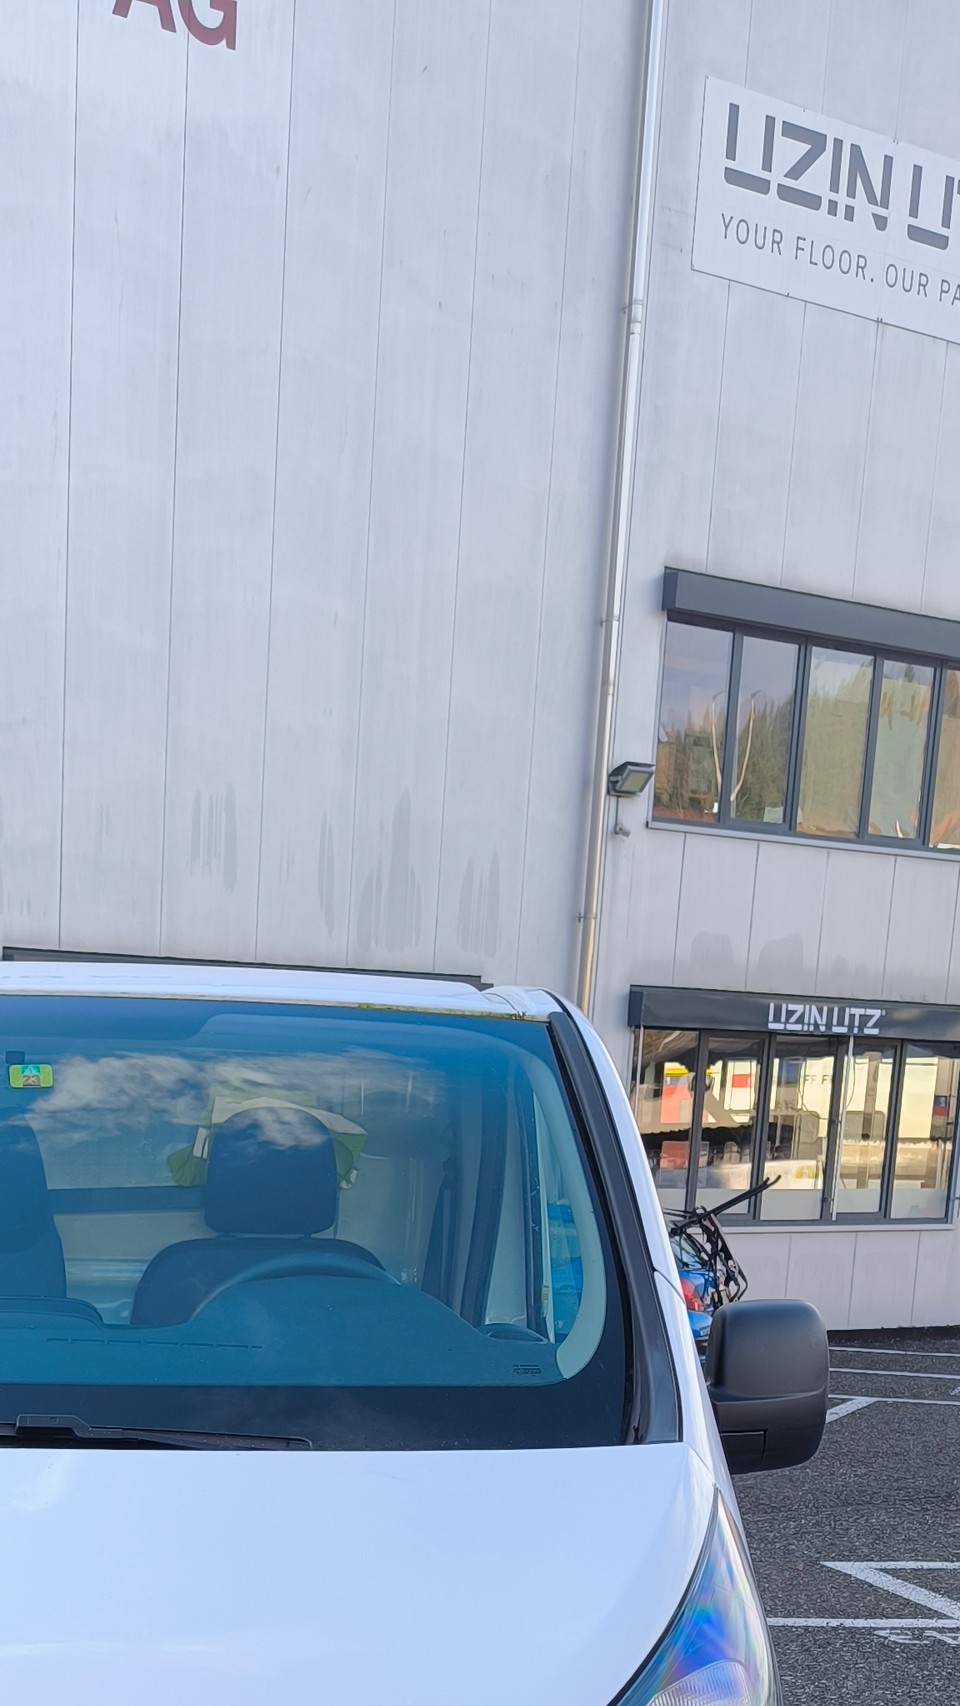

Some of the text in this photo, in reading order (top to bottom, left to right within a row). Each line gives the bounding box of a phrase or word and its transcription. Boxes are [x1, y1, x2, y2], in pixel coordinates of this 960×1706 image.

[723, 102, 960, 251] UZIN U
[721, 212, 784, 256] YOUR
[794, 235, 875, 283] FLOOR.
[884, 263, 930, 298] OUR
[767, 1002, 828, 1033] UZIN
[22, 1074, 40, 1087] 23
